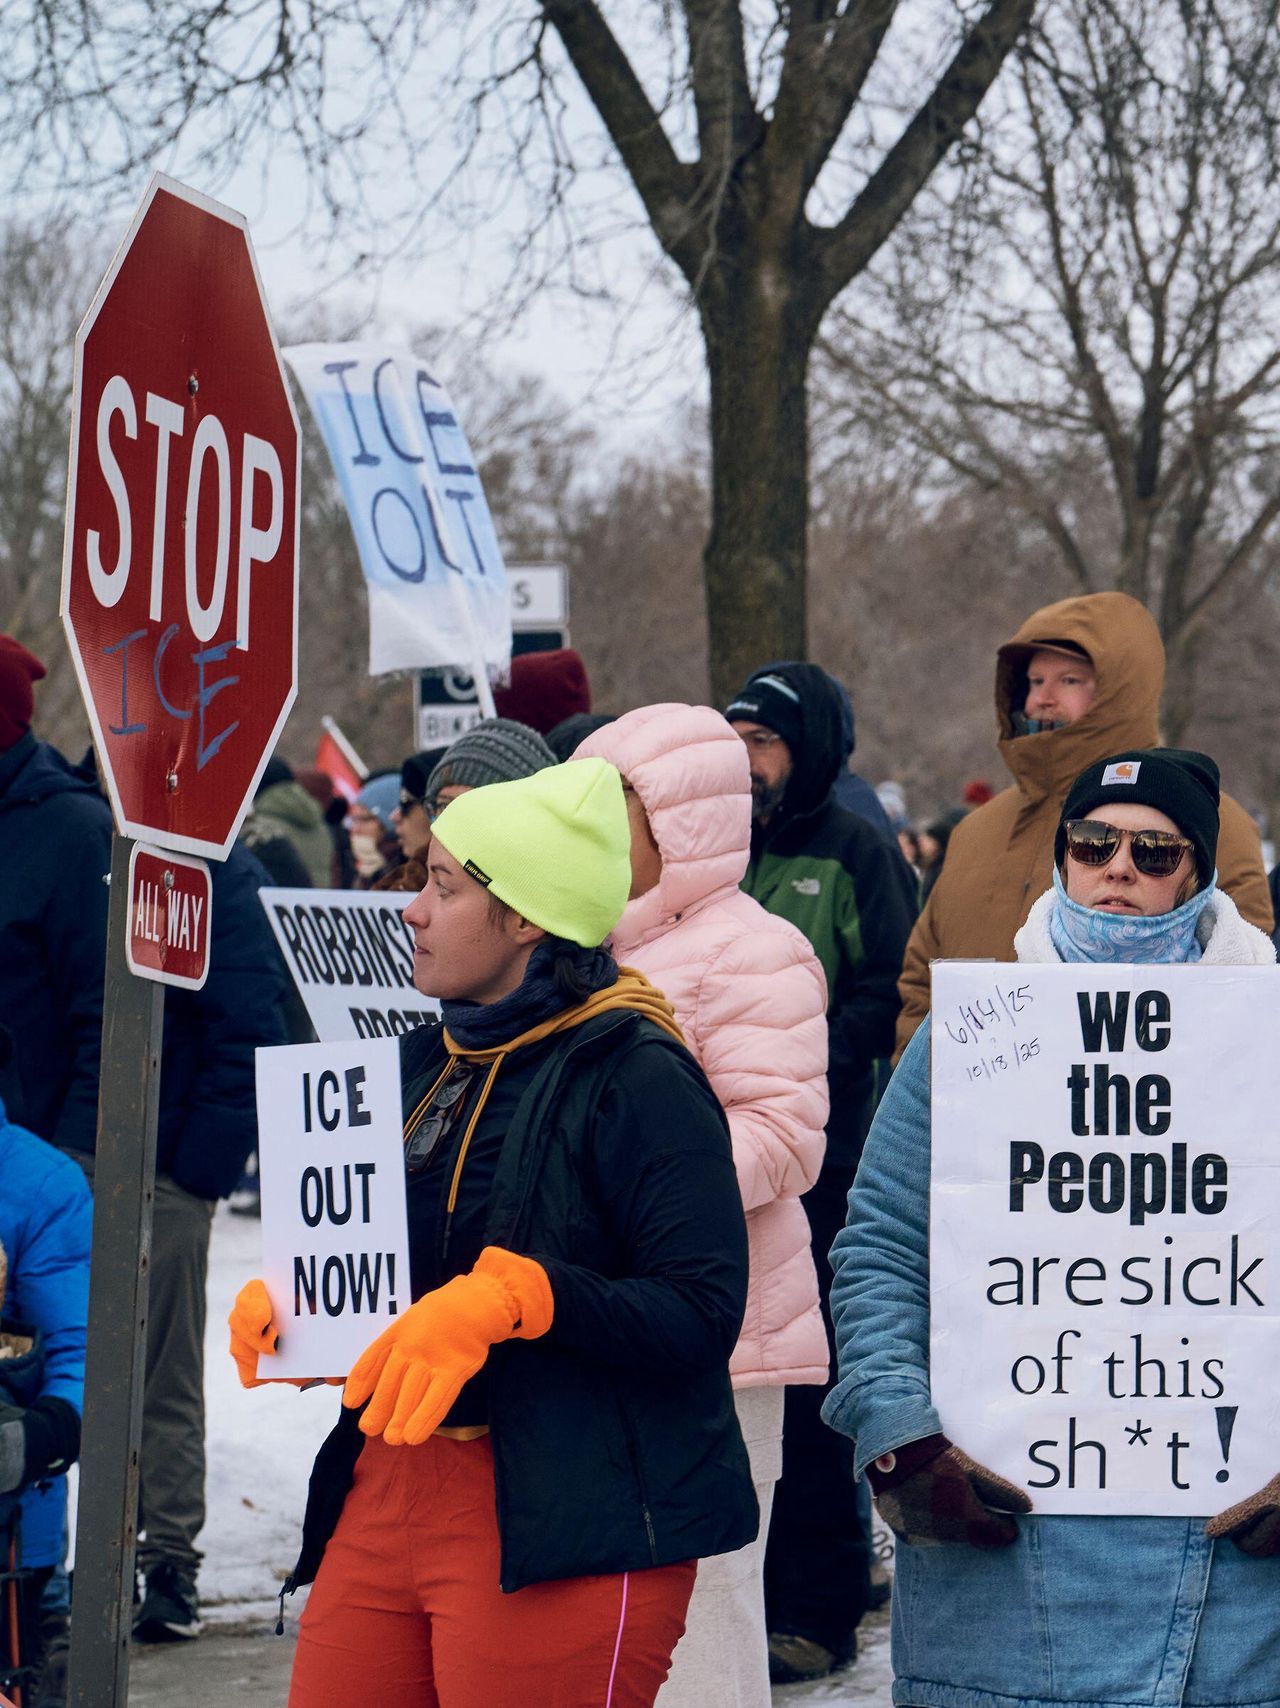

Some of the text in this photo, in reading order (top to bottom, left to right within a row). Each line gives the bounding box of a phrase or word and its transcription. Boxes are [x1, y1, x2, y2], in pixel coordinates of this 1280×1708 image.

[323, 357, 475, 476] ICE
[86, 375, 284, 651] STOP
[370, 482, 486, 583] OUT
[102, 623, 241, 770] ICE
[134, 879, 203, 952] ALL WAY
[1076, 989, 1171, 1053] we
[302, 1065, 372, 1134] ICE
[1067, 1063, 1171, 1137] the
[300, 1162, 377, 1227] OUT
[1009, 1140, 1228, 1226] People
[292, 1253, 398, 1318] NOW!
[1010, 1330, 1225, 1399] of this
